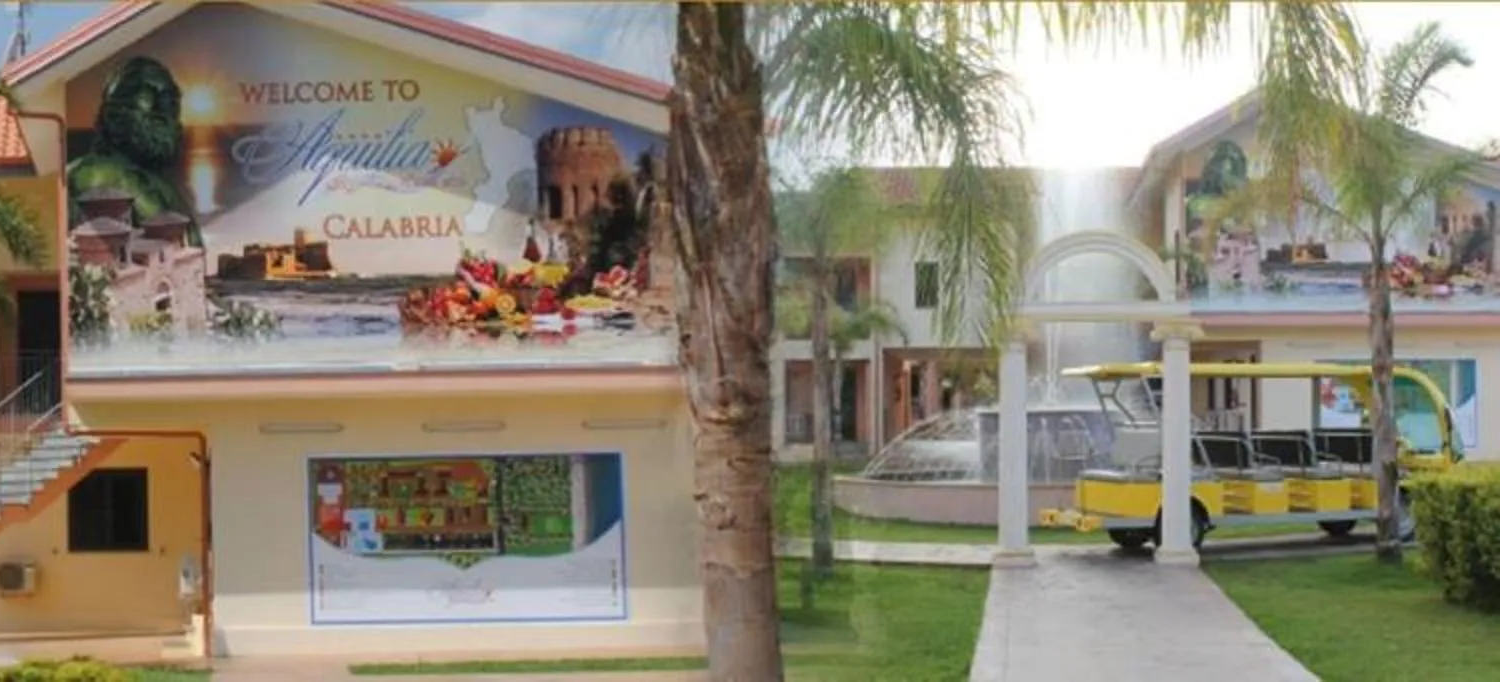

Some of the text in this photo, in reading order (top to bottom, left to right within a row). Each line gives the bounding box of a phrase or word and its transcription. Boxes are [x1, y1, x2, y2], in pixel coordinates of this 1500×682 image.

[238, 79, 421, 104] WELCOME TO
[323, 213, 464, 240] CALABRIA
